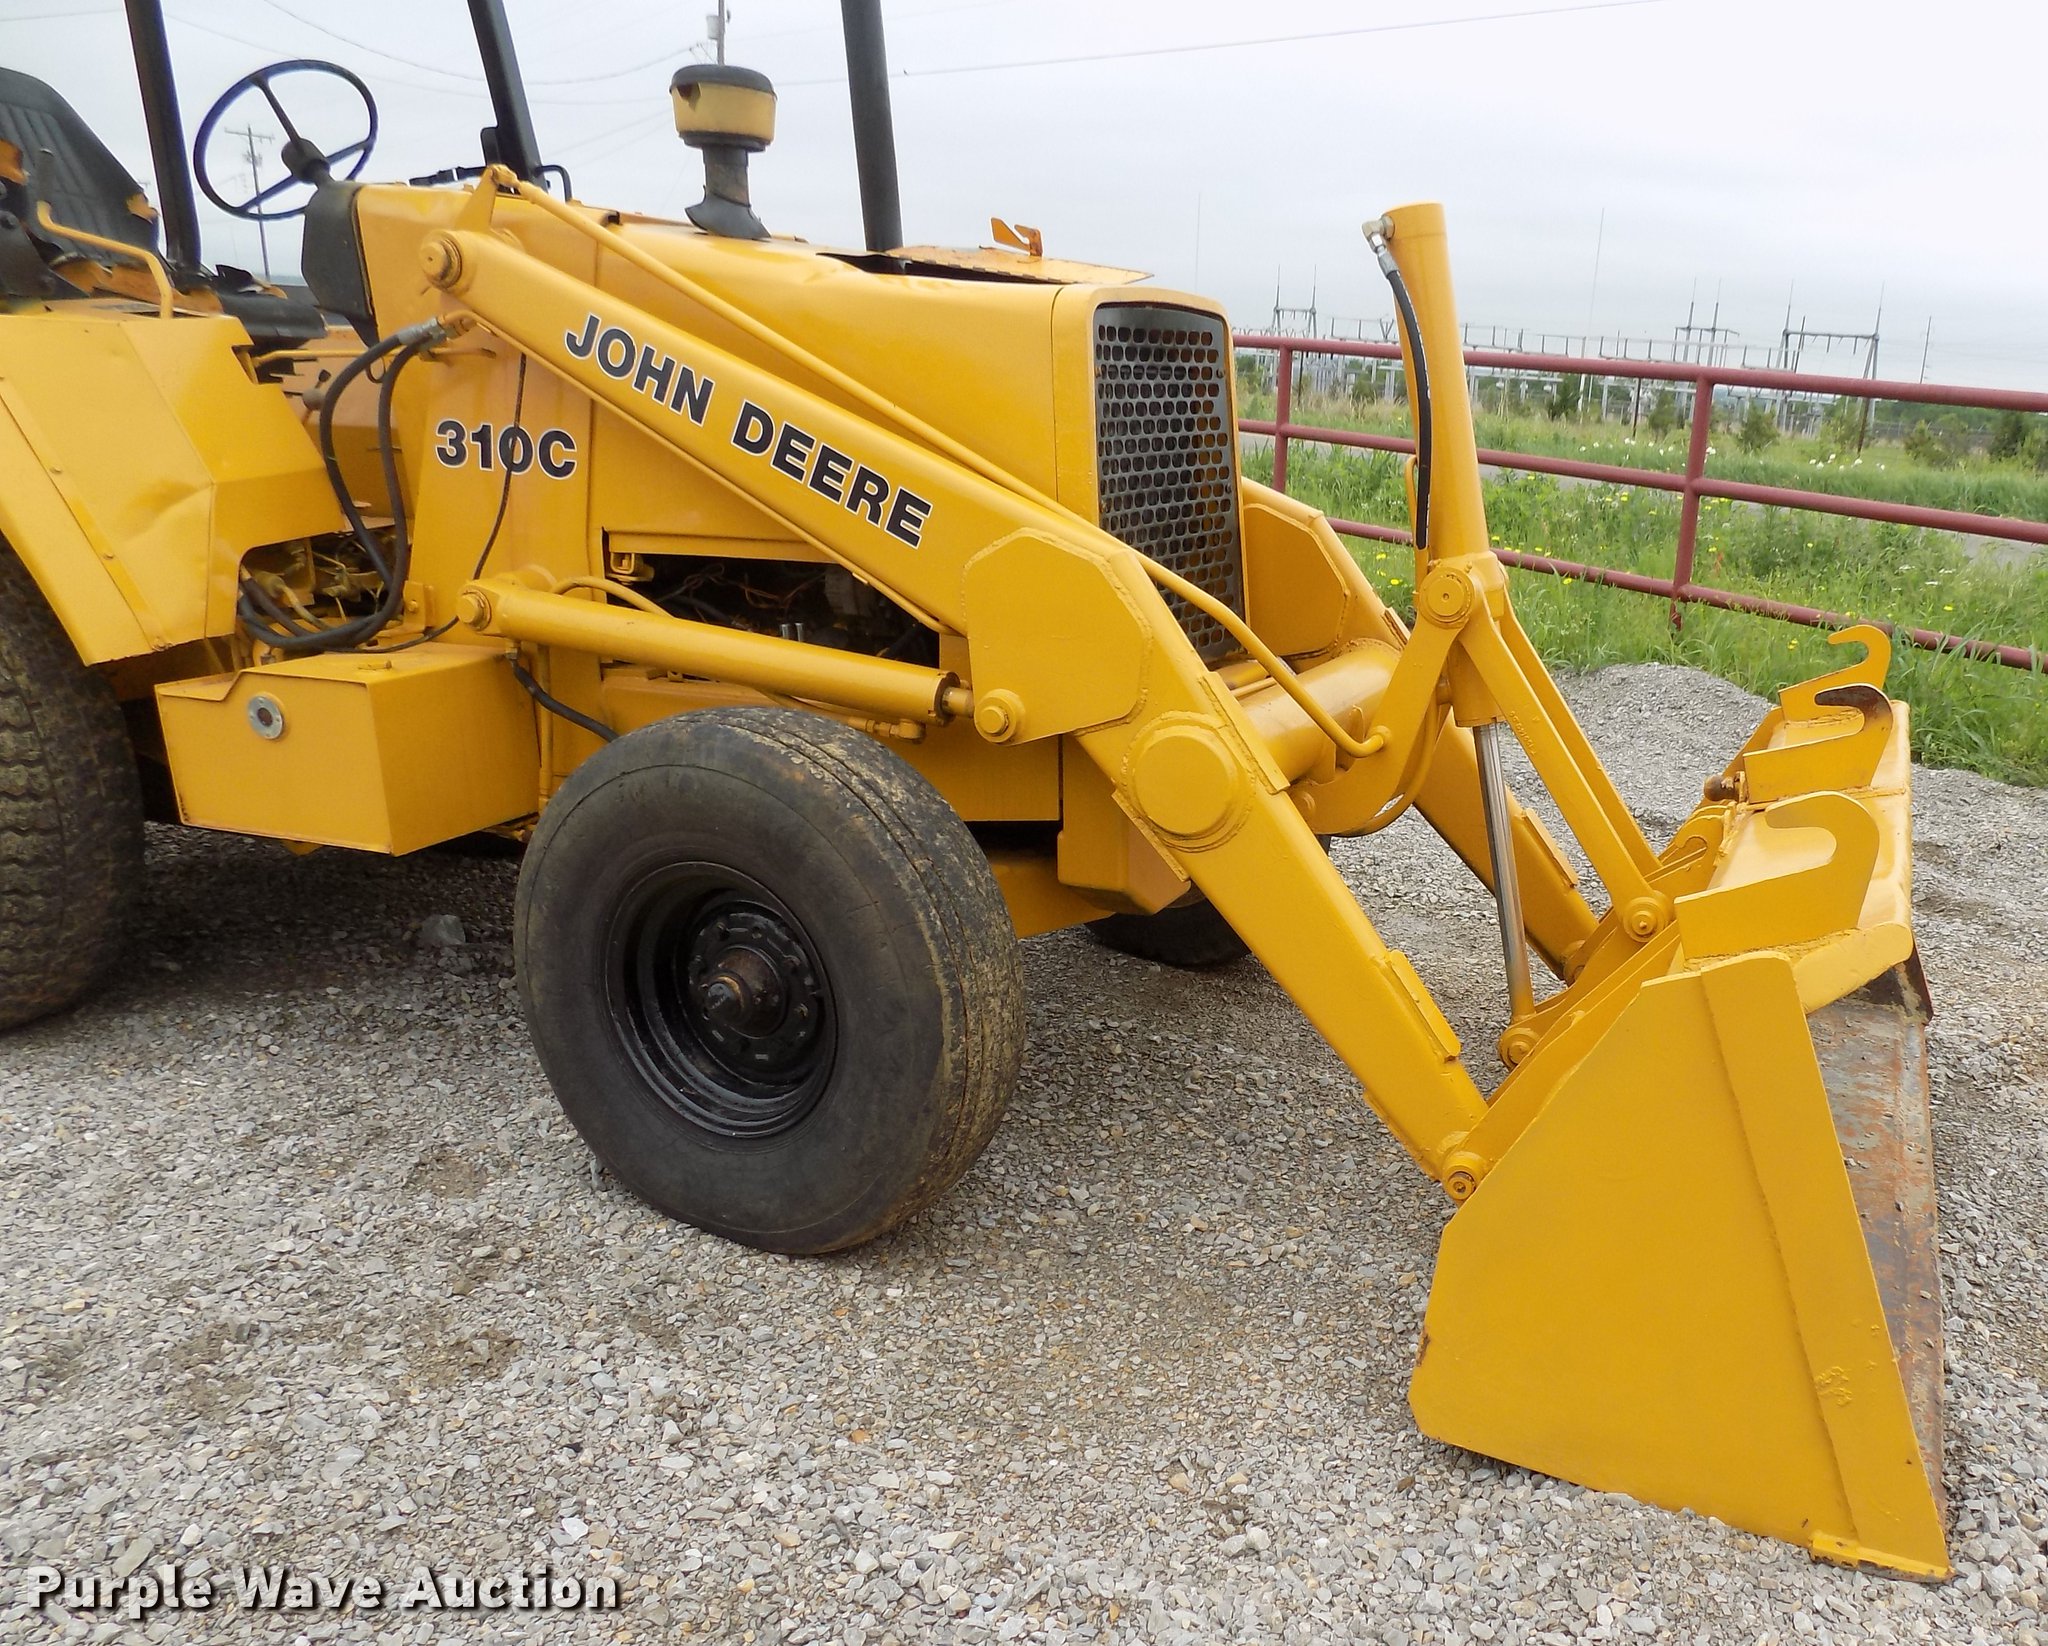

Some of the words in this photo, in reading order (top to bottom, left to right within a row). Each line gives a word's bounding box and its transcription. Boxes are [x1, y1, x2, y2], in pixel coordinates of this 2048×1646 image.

[436, 419, 579, 480] 310C
[565, 313, 716, 427] JOHN
[731, 399, 934, 550] DEERE
